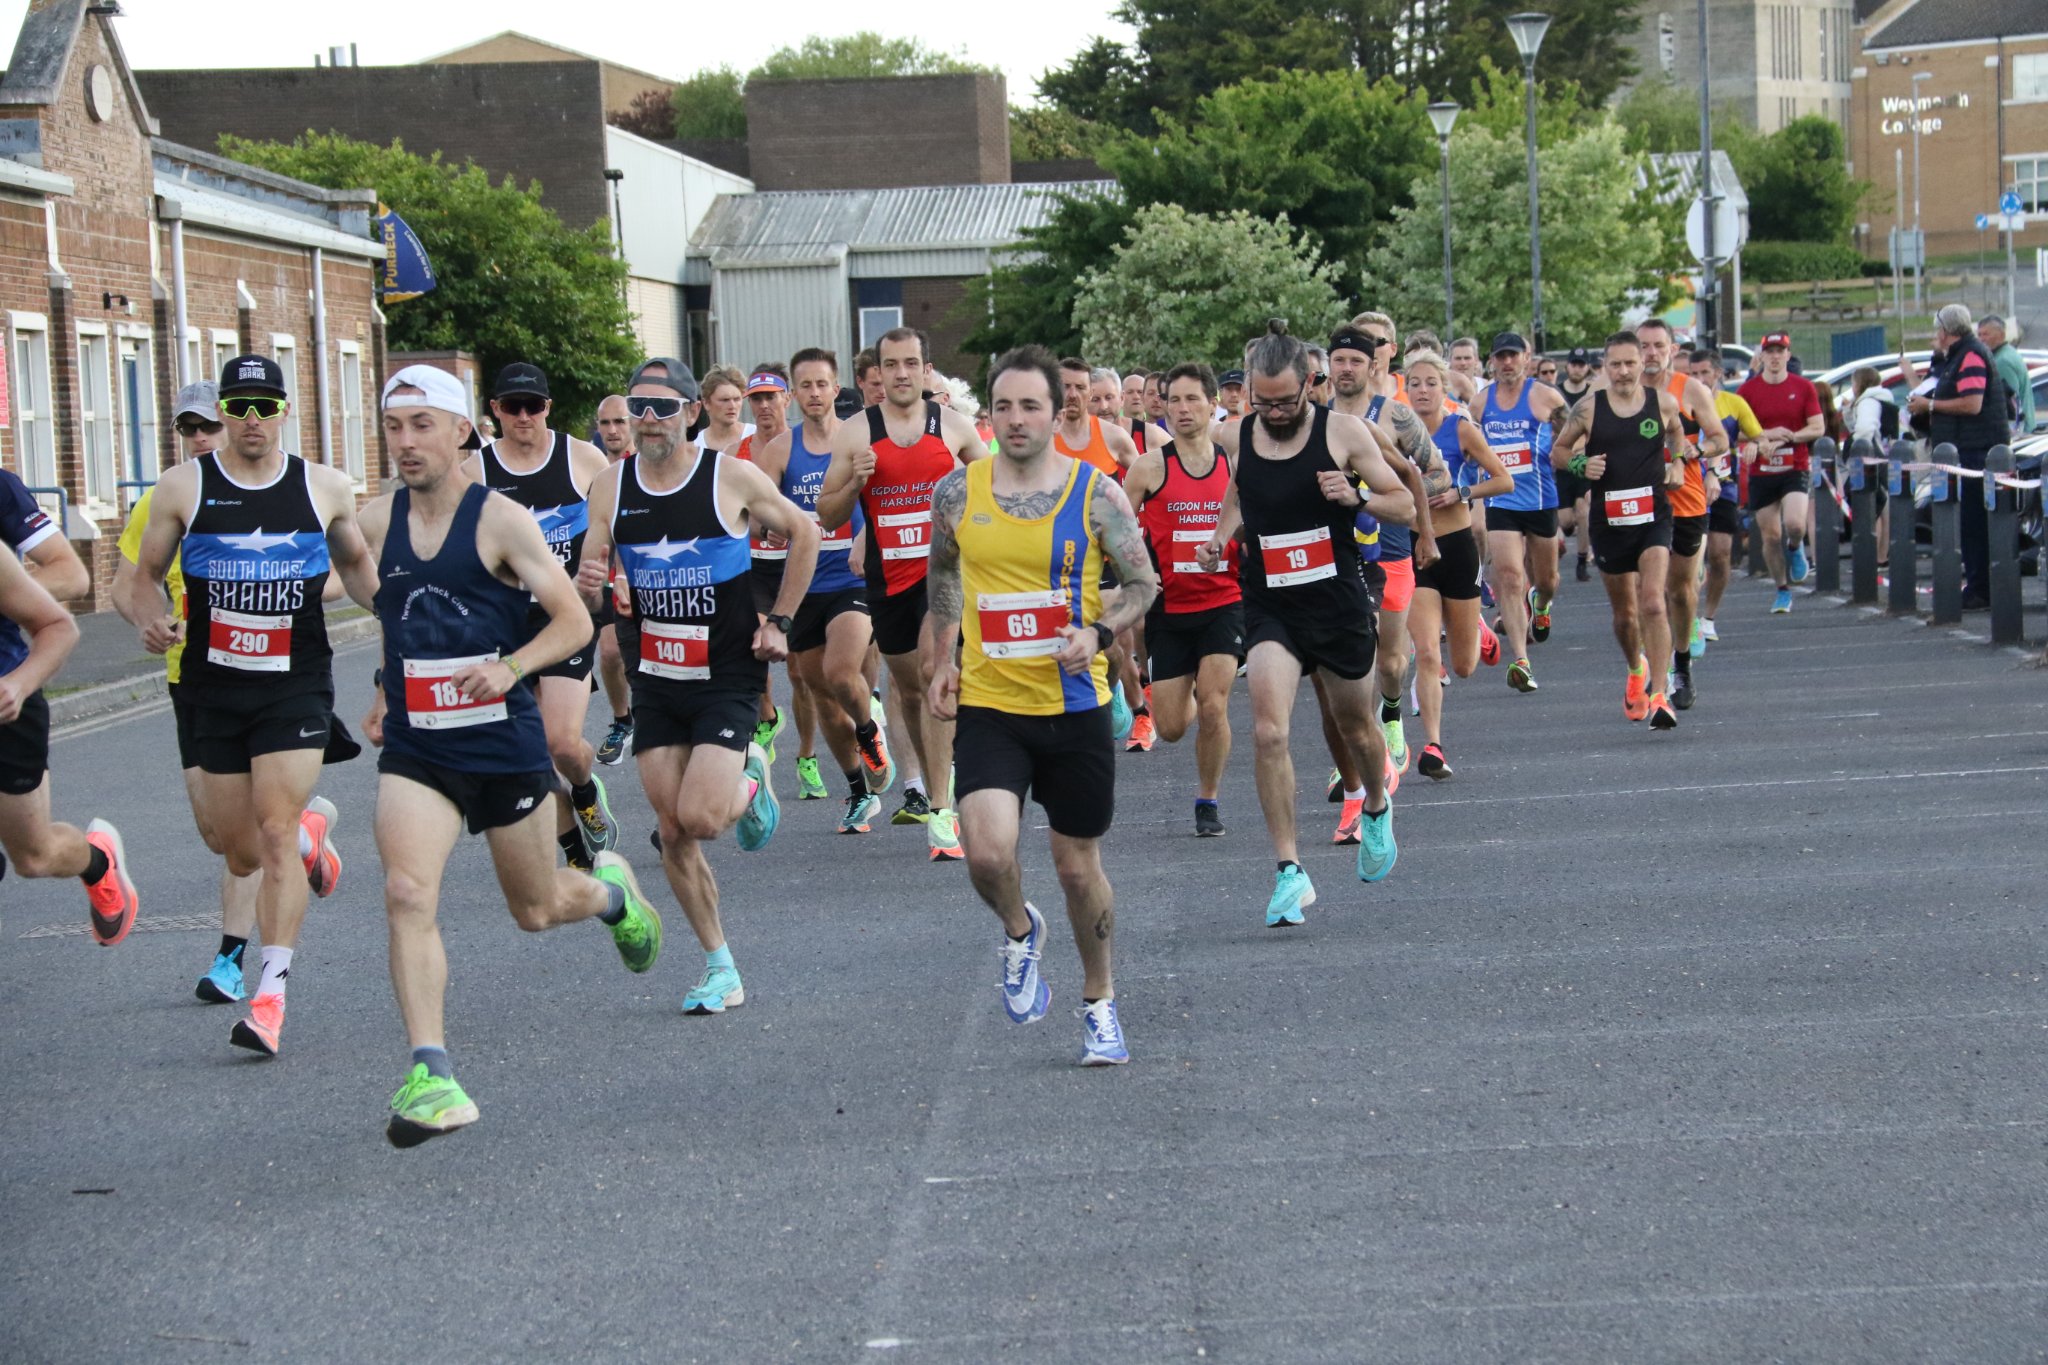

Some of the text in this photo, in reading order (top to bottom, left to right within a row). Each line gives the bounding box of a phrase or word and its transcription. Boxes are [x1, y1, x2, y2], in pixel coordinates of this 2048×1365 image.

[1881, 91, 1969, 114] Weymoh
[383, 222, 398, 288] PURBECK
[1368, 406, 1378, 421] oar
[1500, 452, 1520, 465] 263
[801, 471, 824, 483] CITY
[792, 484, 824, 495] SALIS
[871, 481, 937, 495] EGDON HEA
[803, 495, 811, 504] A
[880, 494, 934, 508] HARRIER
[1167, 501, 1222, 512] EGDON HEA
[1621, 500, 1638, 515] 59
[1178, 514, 1219, 524] HARRIER
[897, 526, 923, 545] 107
[1285, 548, 1309, 569] 19
[208, 560, 306, 580] SOUTH COAST
[633, 565, 713, 588] SOUTH COAST
[208, 580, 304, 611] SHARKS
[401, 584, 469, 621] Twemlow Track Club
[637, 586, 716, 618] SHARKS
[1007, 612, 1038, 638] 69
[229, 629, 269, 654] 290
[655, 639, 686, 663] 140
